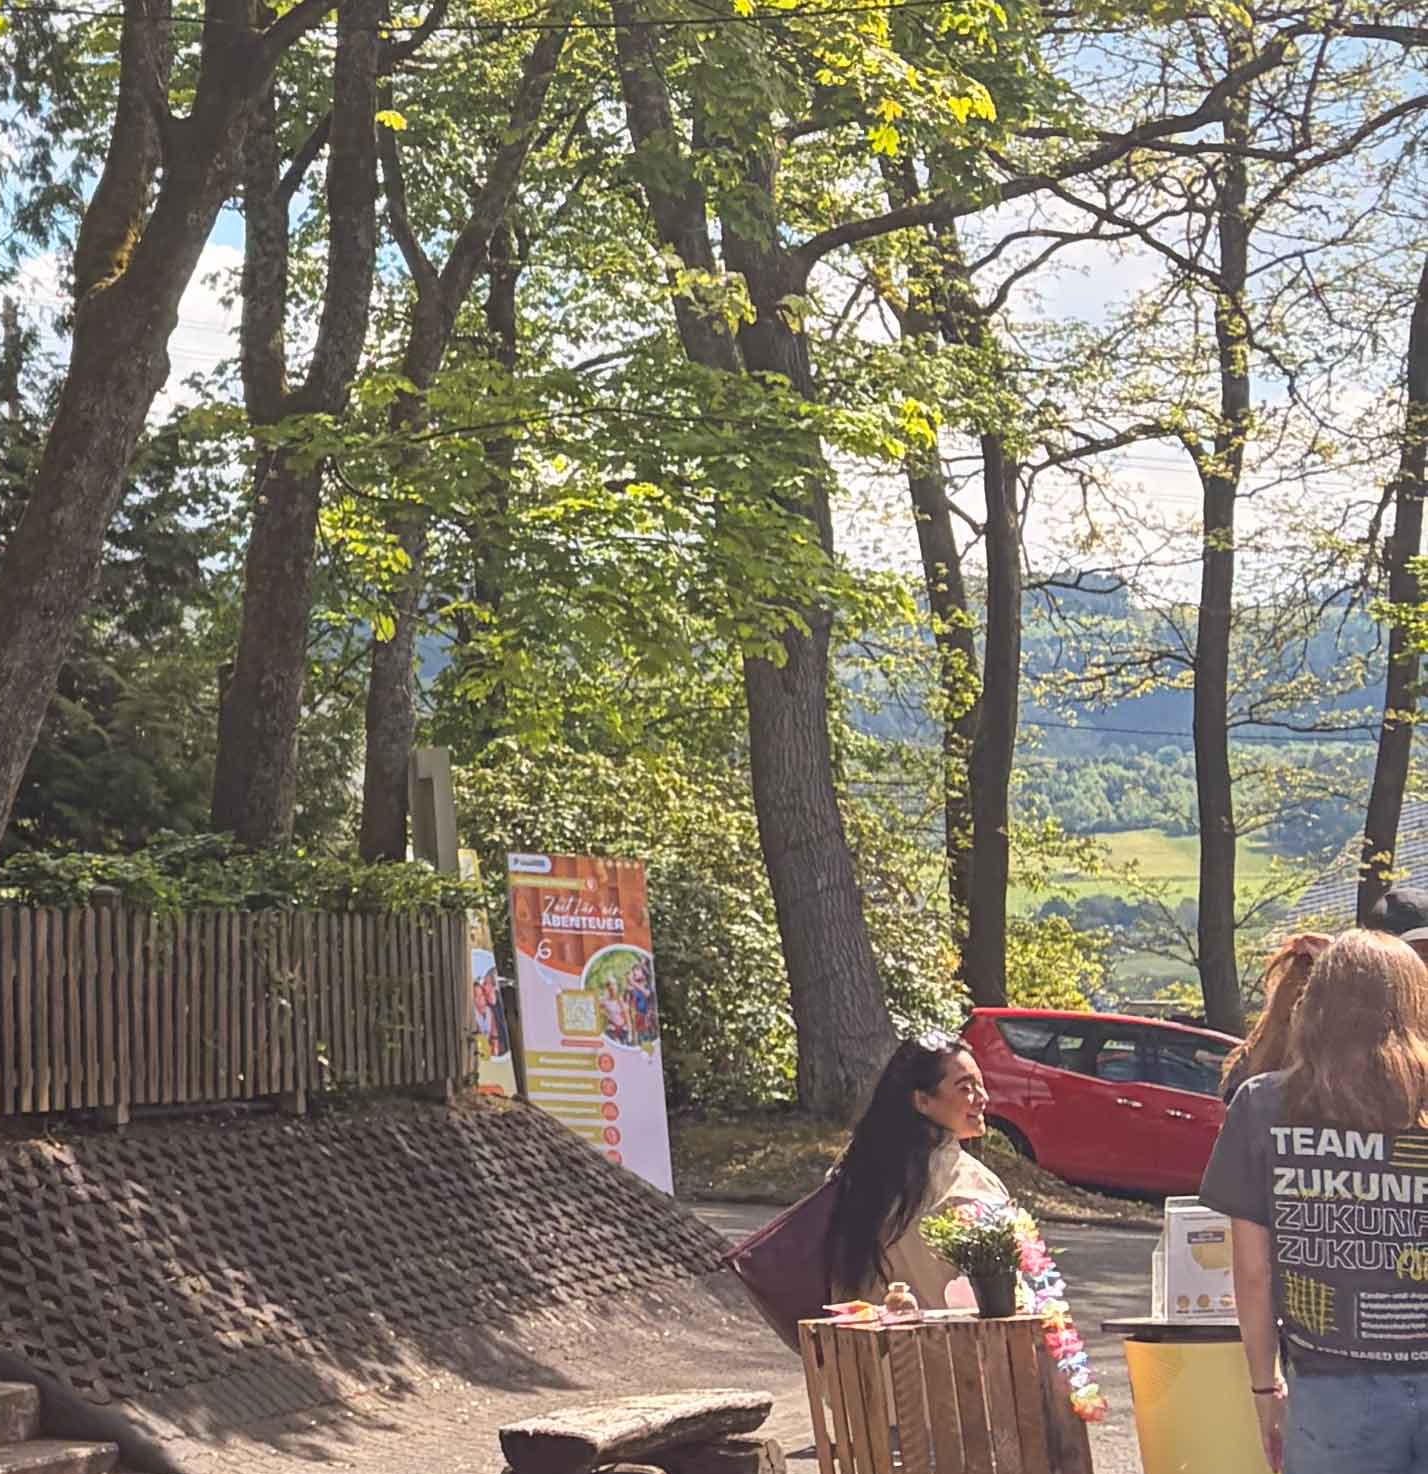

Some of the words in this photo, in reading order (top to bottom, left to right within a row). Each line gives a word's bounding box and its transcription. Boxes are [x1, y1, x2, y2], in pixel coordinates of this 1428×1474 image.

[541, 911, 624, 931] ABENTEUER
[1270, 1126, 1384, 1161] TEAM
[1350, 1350, 1392, 1361] BASED
[1394, 1350, 1409, 1361] IN
